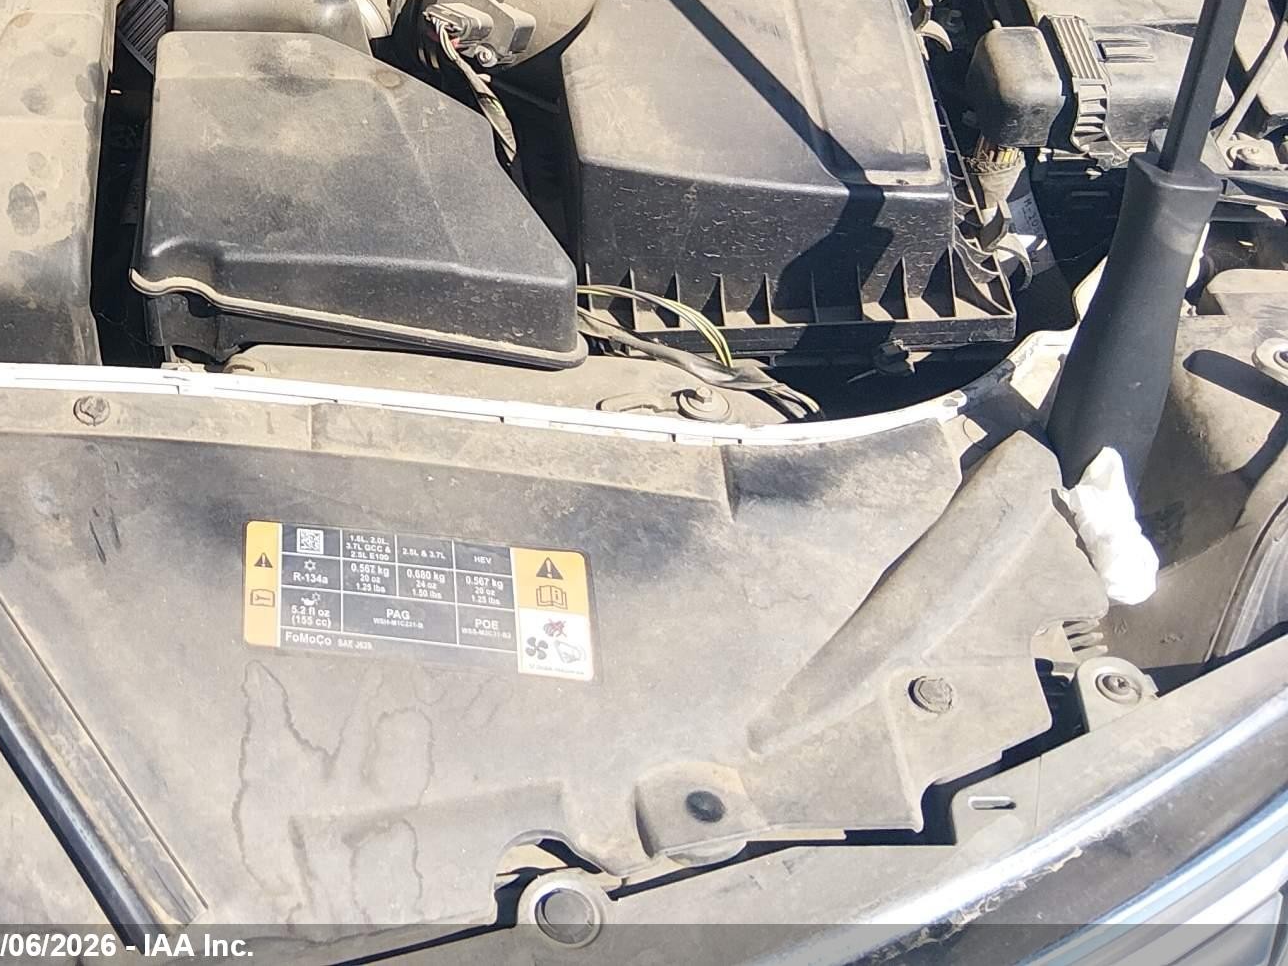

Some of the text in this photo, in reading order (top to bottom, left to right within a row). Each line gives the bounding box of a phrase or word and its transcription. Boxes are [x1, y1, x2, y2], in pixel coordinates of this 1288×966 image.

[346, 542, 363, 550] 3.7L
[364, 544, 384, 552] GCC
[369, 552, 390, 561] E100
[473, 555, 492, 564] HEV
[377, 565, 390, 578] kg
[406, 568, 446, 584] 0.680 kg
[293, 572, 329, 584] R-134a
[360, 573, 381, 584] 20 oz
[465, 575, 504, 591] 0.567 kg
[373, 584, 386, 593] lbs
[416, 579, 437, 590] 24 oz
[429, 590, 442, 599] lbs
[474, 586, 496, 596] 20 oz
[488, 596, 501, 605] lbs
[291, 605, 331, 618] 5.2 fl oz
[386, 608, 410, 620] PAG
[291, 615, 332, 629] (155 cc)
[475, 618, 499, 630] POE
[285, 631, 332, 646] FoMoCo
[337, 638, 353, 649] SAE
